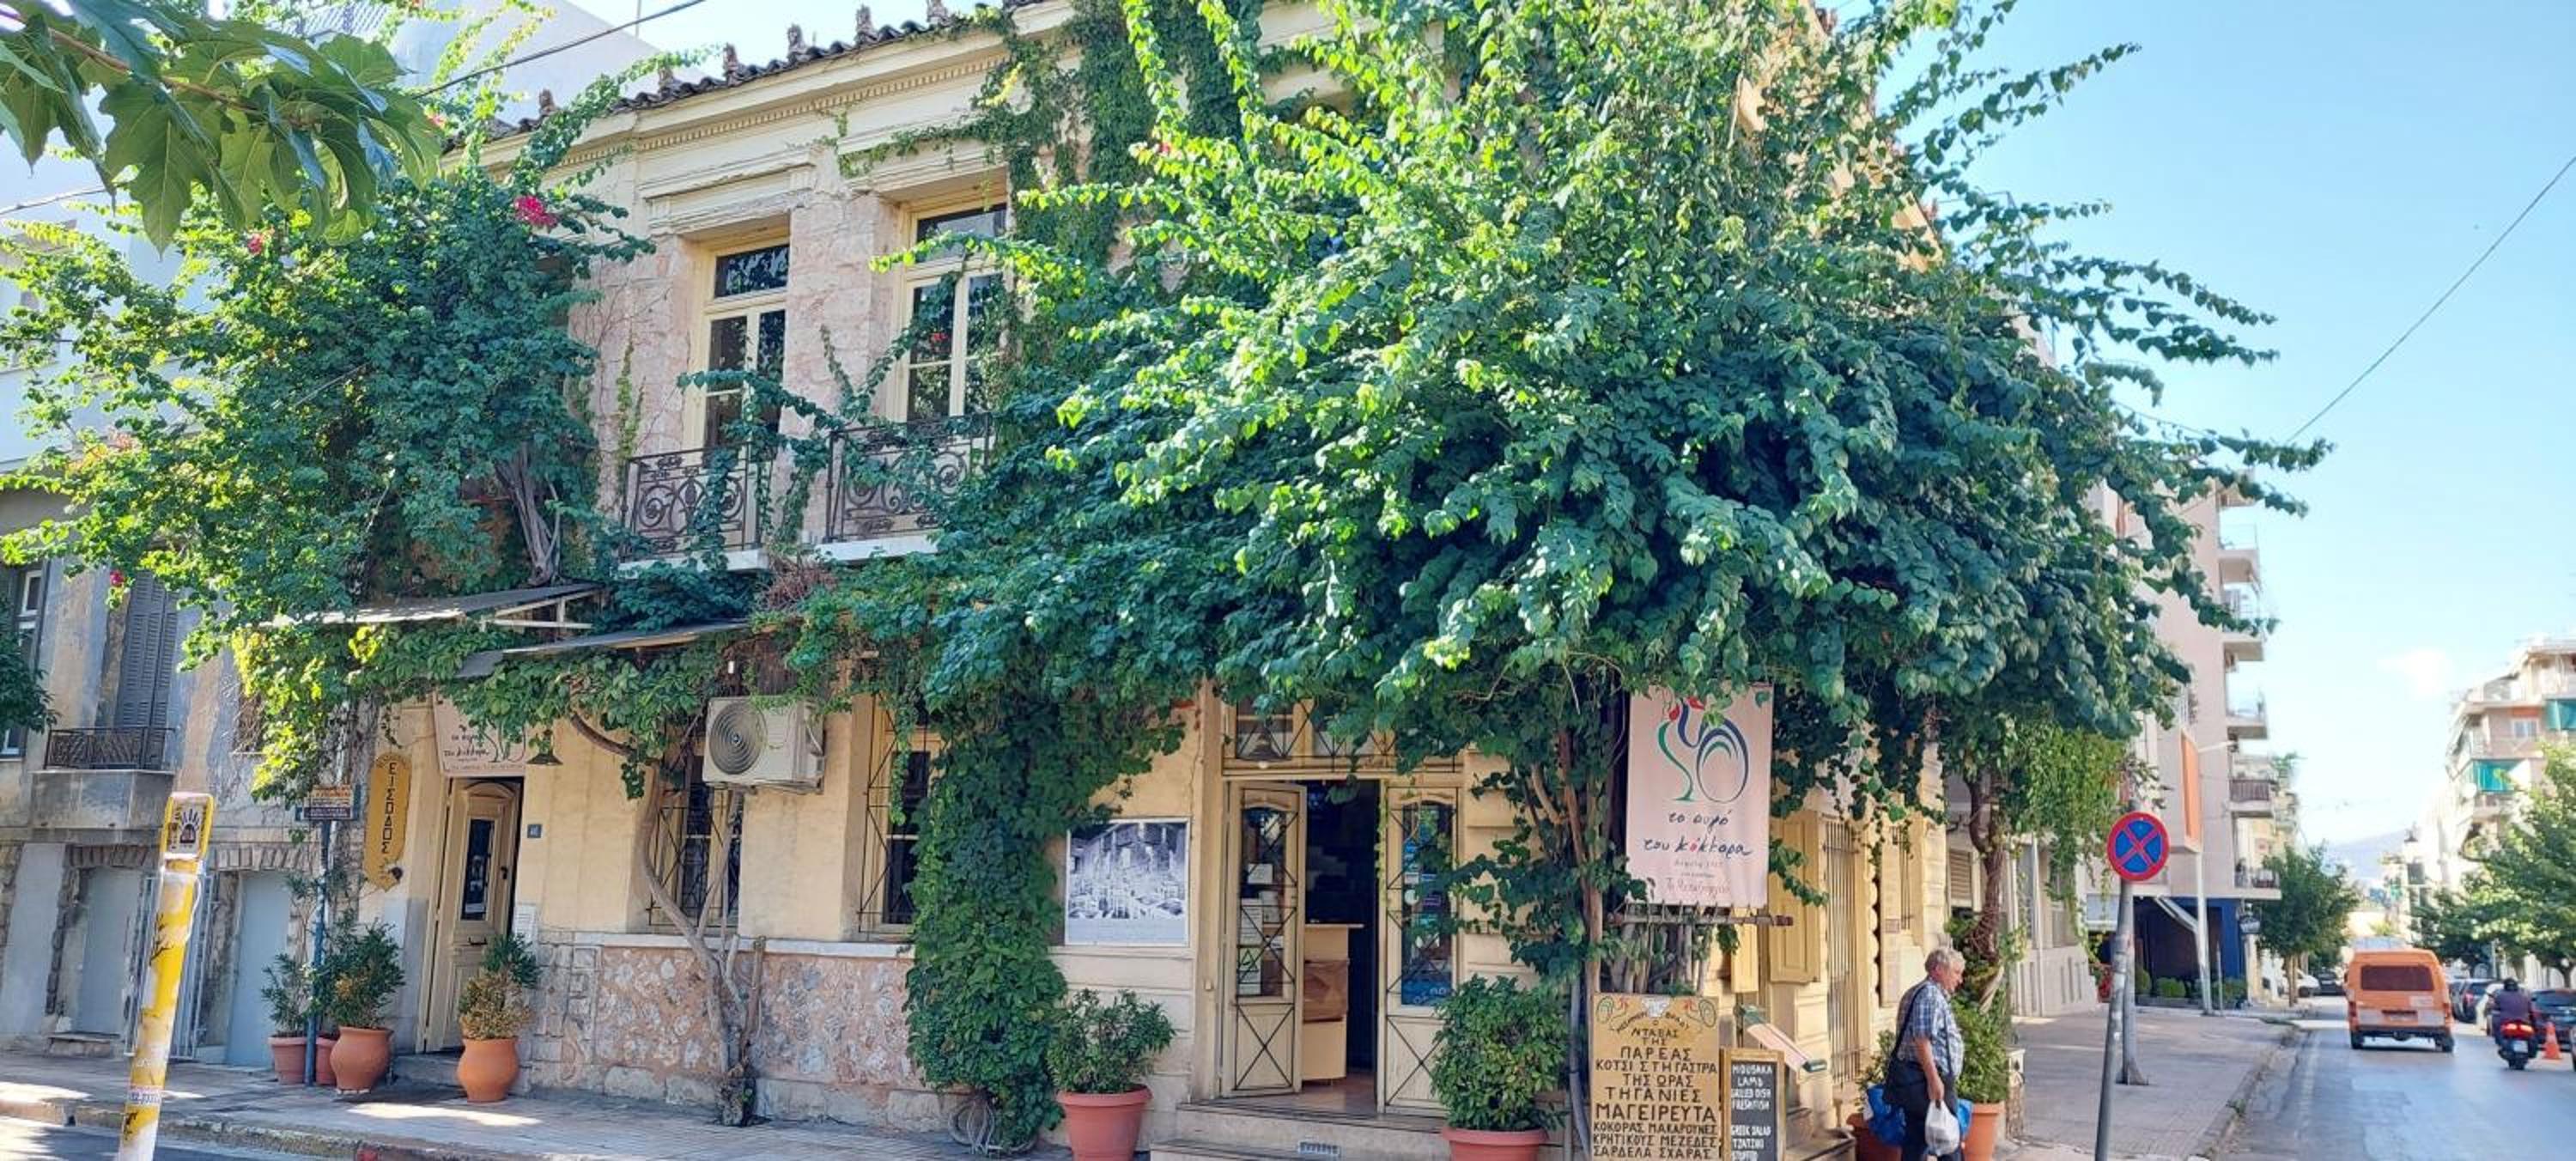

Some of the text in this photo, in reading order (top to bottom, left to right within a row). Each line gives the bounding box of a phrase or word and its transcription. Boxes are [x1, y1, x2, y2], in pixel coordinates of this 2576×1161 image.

[381, 762, 398, 854] ΕΙΣΟΔΟΣ
[1668, 810, 1733, 835] το αυγό
[1643, 839, 1670, 851] του
[1631, 1028, 1680, 1038] ΝΤΑΒΑΣ
[1642, 1037, 1667, 1046] ΤΗΣ
[1620, 1046, 1692, 1061] ΠΑΡΕΑΣ
[1595, 1059, 1632, 1072] ΚΟΤΣΙ
[1675, 1062, 1718, 1073] ΓΑΣΤΡΑ
[1732, 1065, 1773, 1075] MOUSAKA
[1622, 1073, 1694, 1088] ΤΗΣ ΩΡΑΣ
[1605, 1086, 1702, 1103] ΤΗΓΑΝΙΕΣ
[1595, 1103, 1717, 1122] ΜΑΓΕΙΡΕΥΤΑ
[1593, 1121, 1717, 1134] ΚΟΚΟΡΑΣ ΜΑΚΑΡΟΥΝΕΣ
[1593, 1134, 1717, 1148] ΚΡΗΤΙΚΟΥΣ ΜΕΖΕΔΕΣ
[1593, 1146, 1711, 1159] ΣΑΡΔΕΛΑ ΣΧΑΡΑΣ
